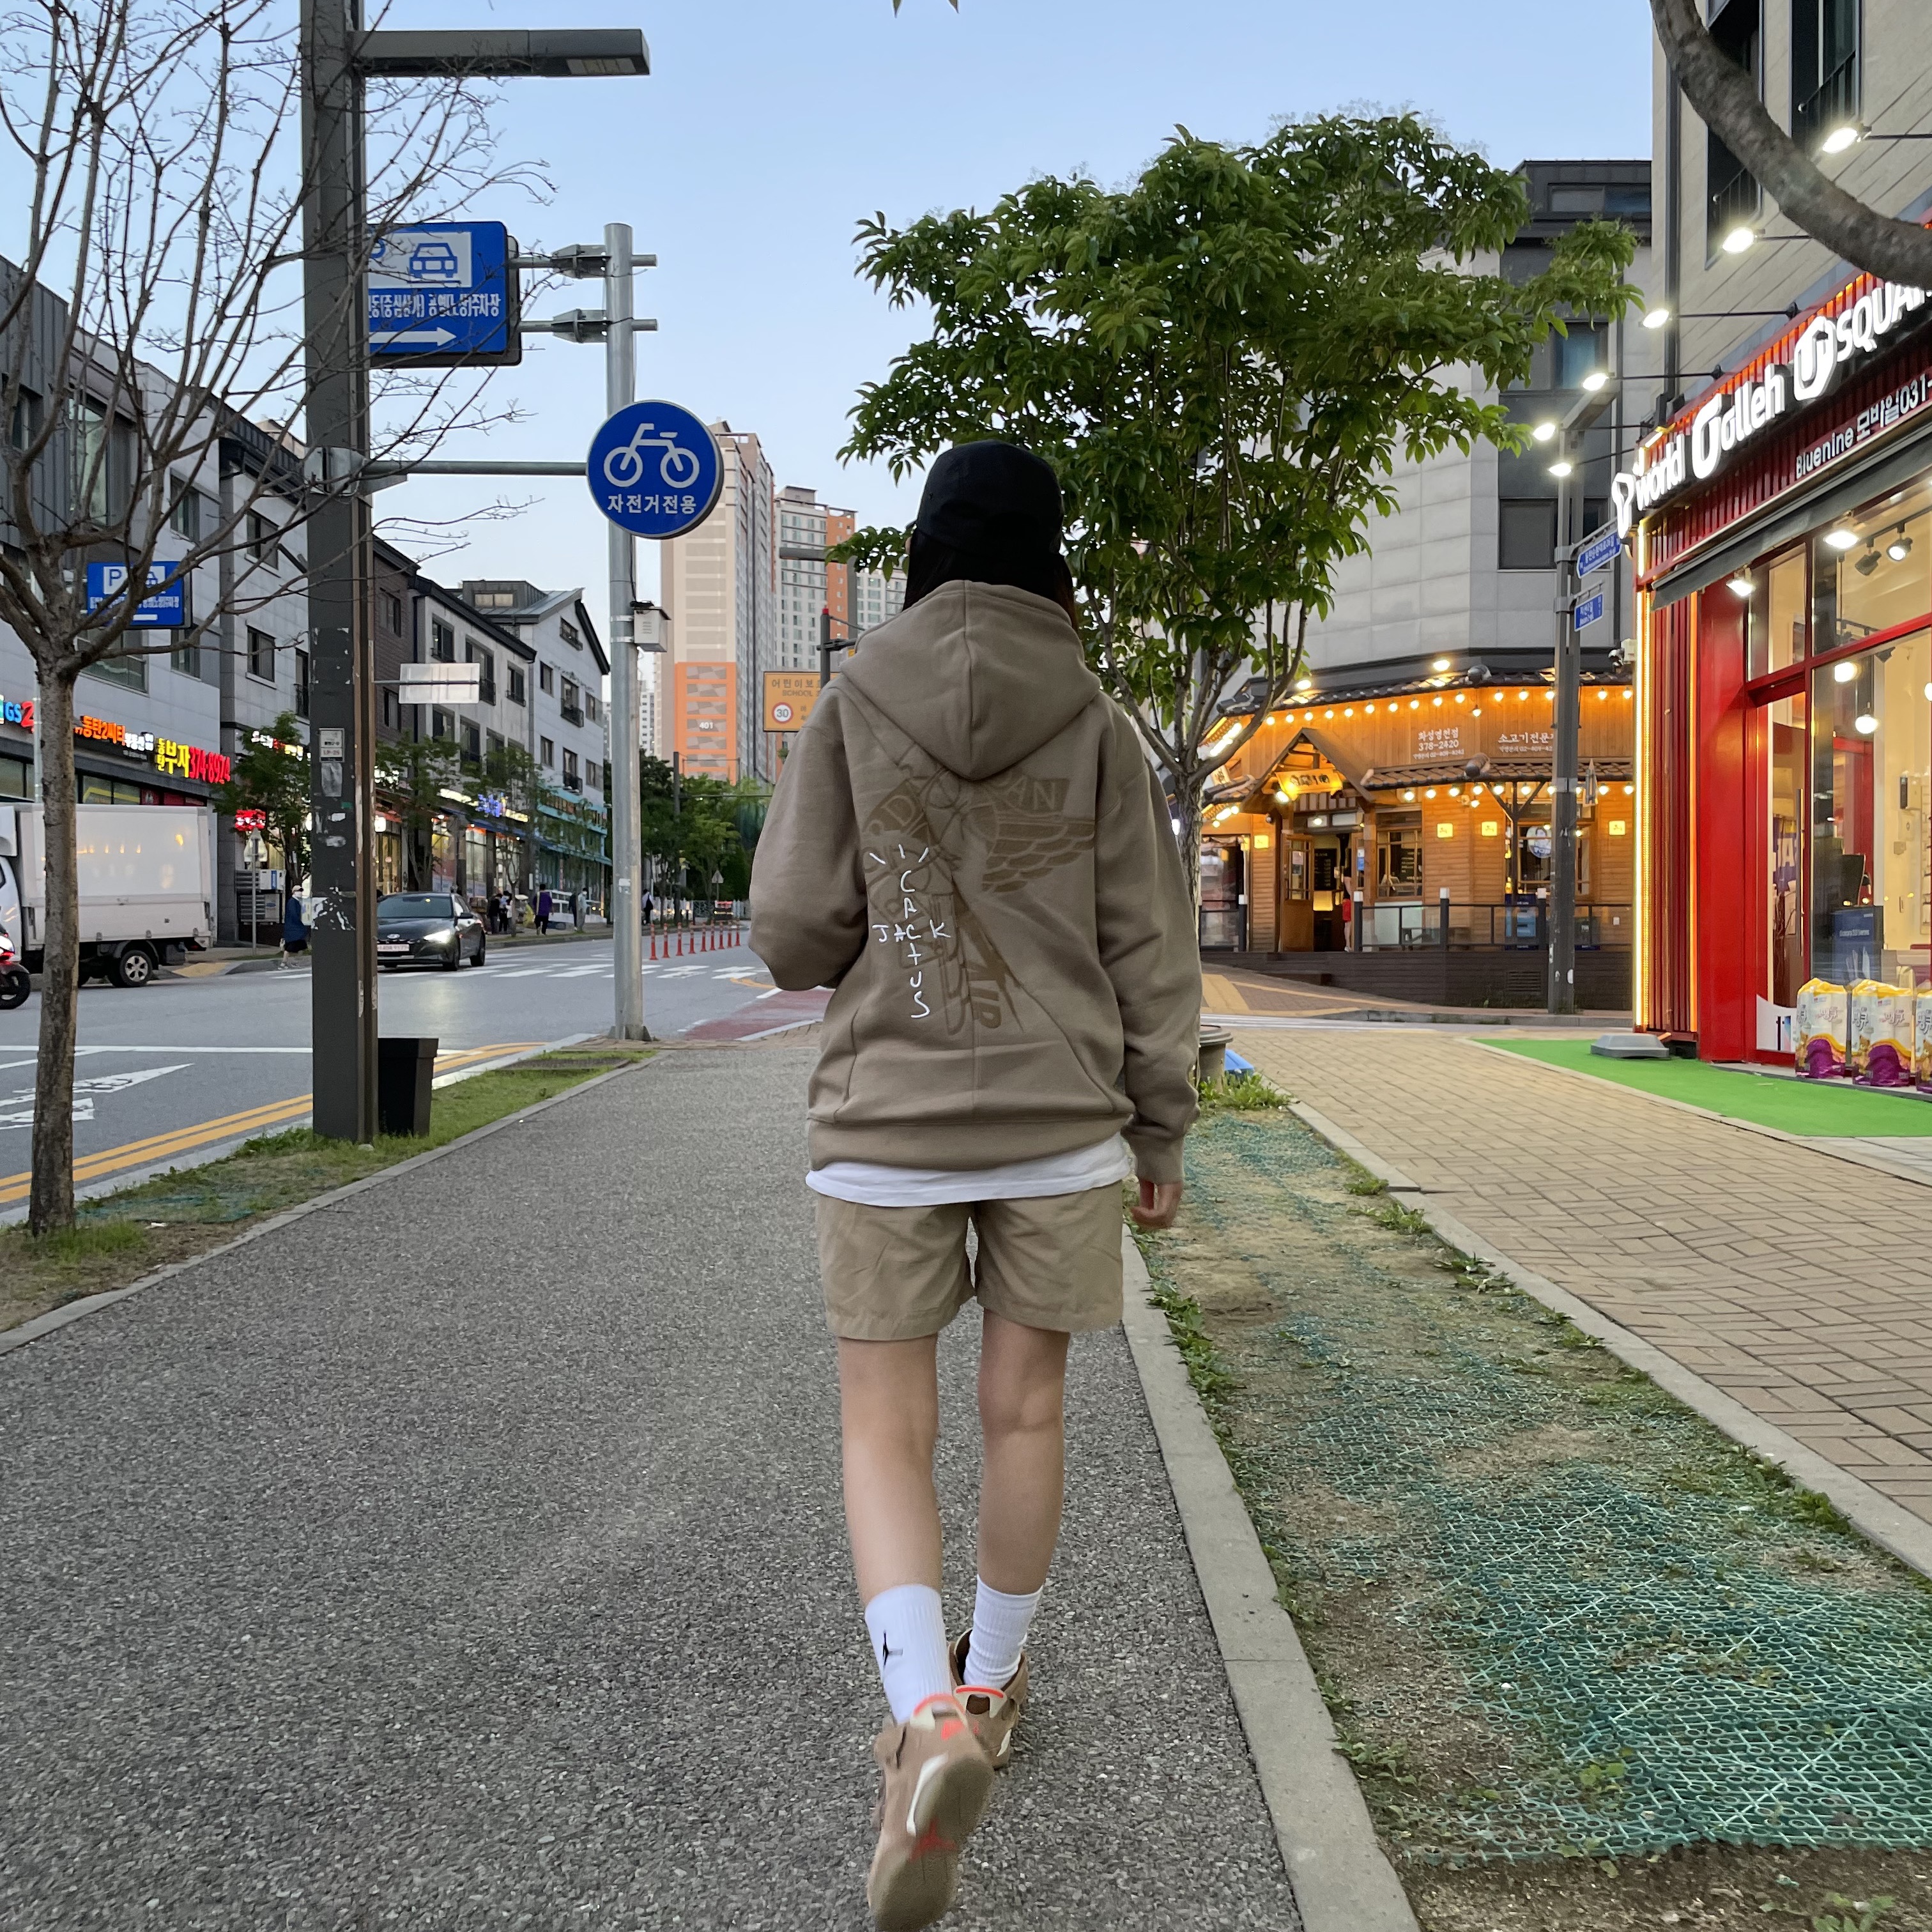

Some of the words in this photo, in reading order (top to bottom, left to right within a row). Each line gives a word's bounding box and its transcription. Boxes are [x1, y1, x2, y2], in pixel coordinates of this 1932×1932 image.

[1636, 433, 1685, 511] world
[1836, 282, 1932, 363] SQUA
[1796, 425, 1853, 479] Bluenine
[1857, 388, 1899, 441] 모바일
[608, 493, 697, 514] 자전거전용
[4, 701, 34, 732] GS2
[776, 709, 789, 718] 30
[1418, 739, 1459, 752] 378-2420
